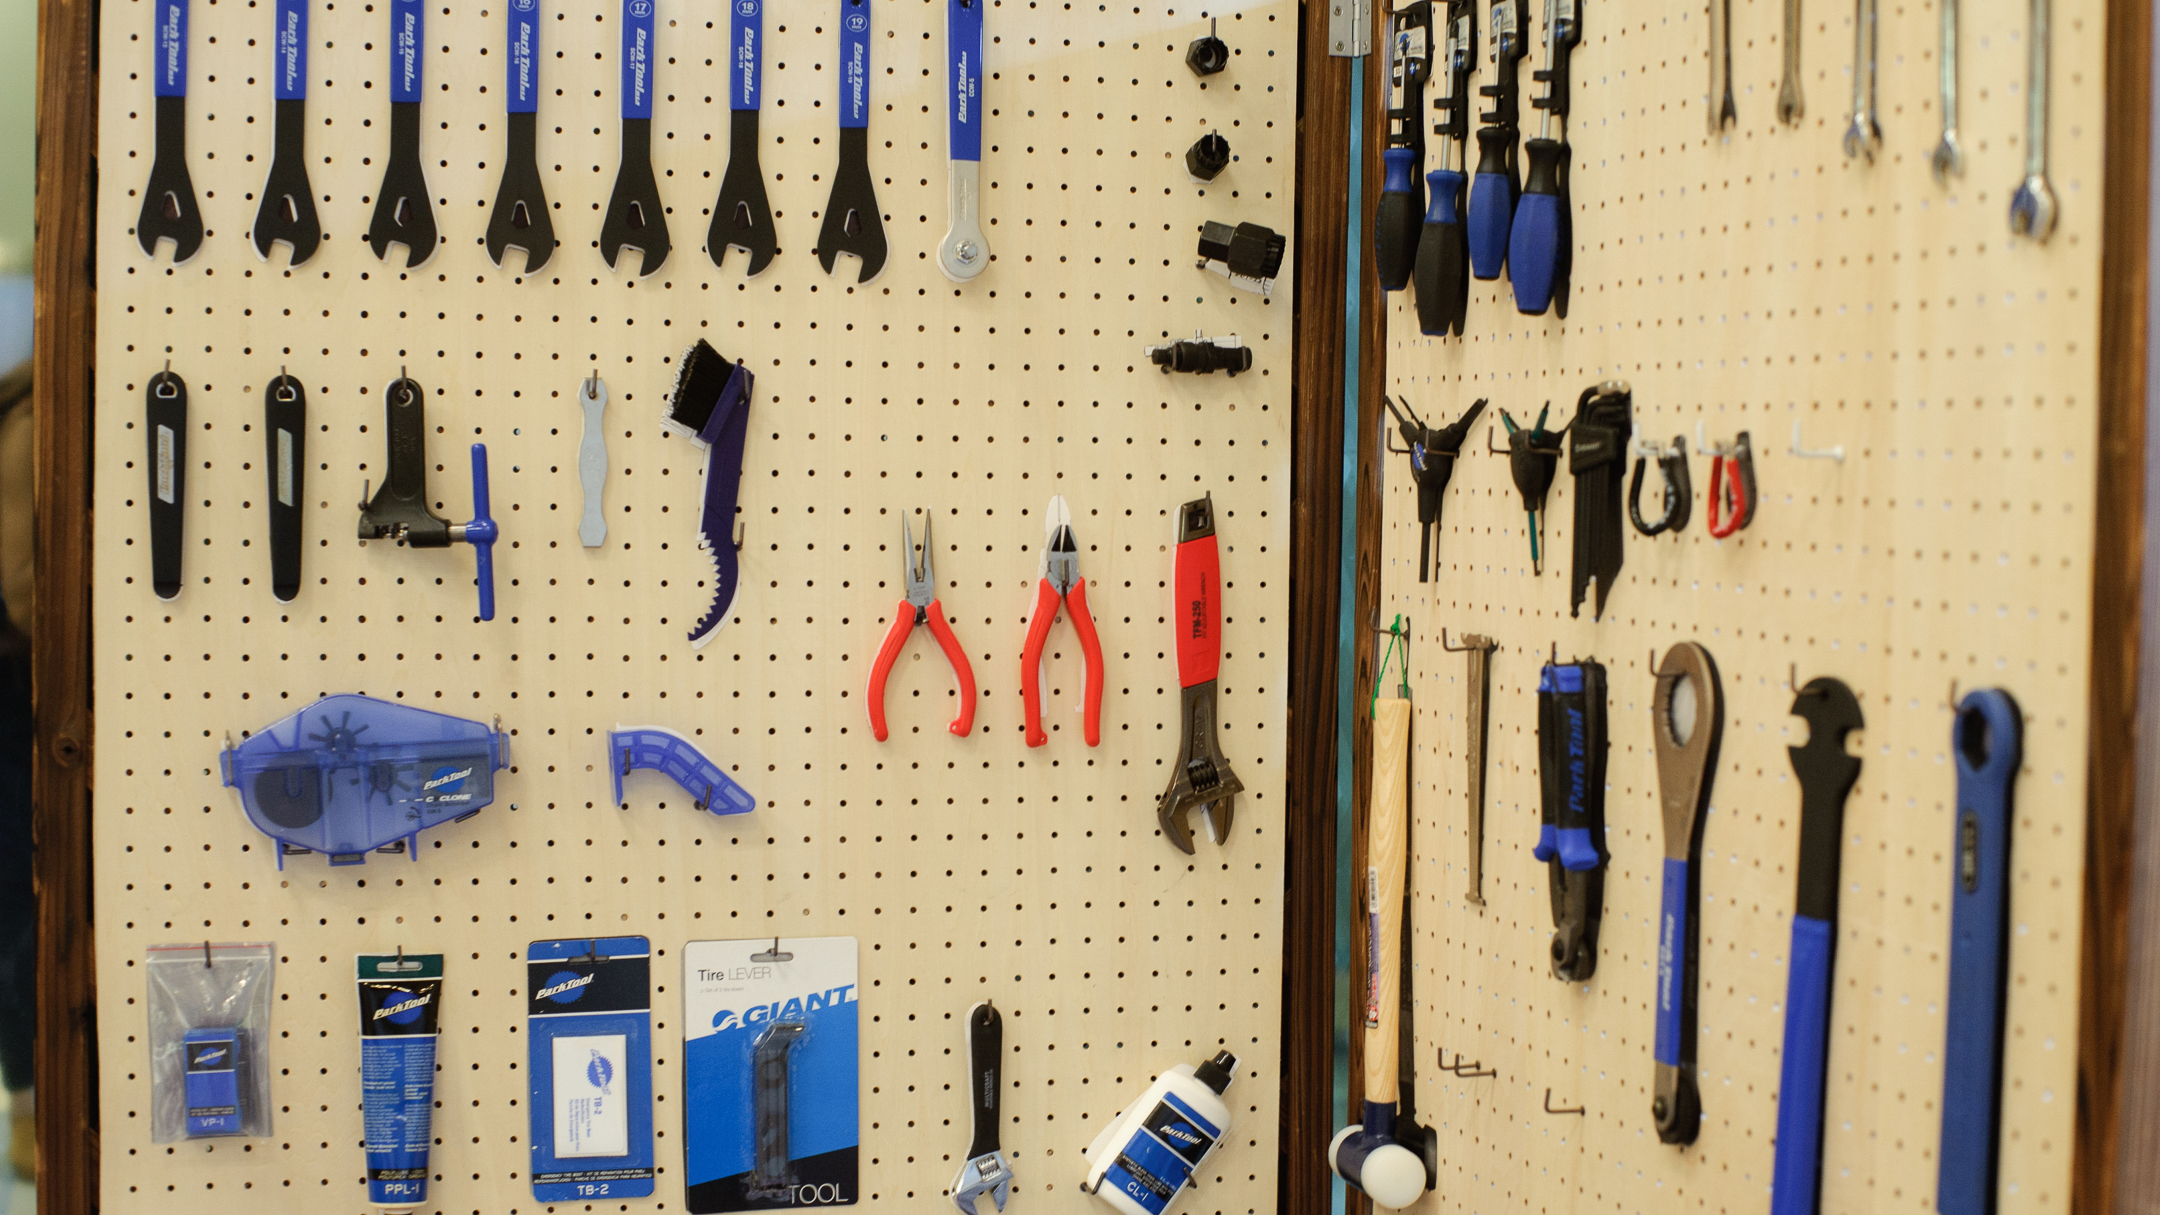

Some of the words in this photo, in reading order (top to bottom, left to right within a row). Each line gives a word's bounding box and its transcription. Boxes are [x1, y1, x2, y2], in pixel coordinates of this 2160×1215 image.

[742, 2, 753, 10] 18
[170, 5, 180, 39] Park
[287, 11, 298, 45] Park
[405, 12, 415, 46] Park
[520, 22, 530, 56] Park
[636, 28, 646, 62] Park
[744, 27, 754, 60] Park
[168, 41, 179, 72] Tool
[287, 46, 298, 78] Tool
[405, 48, 415, 78] Tool
[854, 42, 863, 76] Park
[520, 57, 530, 88] Tool
[635, 62, 645, 93] Tool
[744, 62, 754, 91] Tool
[958, 62, 966, 92] Tool
[854, 76, 863, 106] Tool
[958, 92, 966, 123] Park
[1192, 601, 1202, 639] TFM-250
[423, 767, 472, 790] ParkTool
[535, 973, 594, 1000] ParkTool
[698, 969, 724, 981] Tire
[728, 966, 771, 980] LEVER
[373, 994, 431, 1020] ParkTool
[742, 984, 854, 1027] GIANT
[1160, 1125, 1200, 1144] ParkTool
[385, 1183, 419, 1195] PPL-1
[577, 1184, 609, 1196] TB-2
[789, 1183, 848, 1204] TOOL
[1127, 1182, 1148, 1201] CL-1
